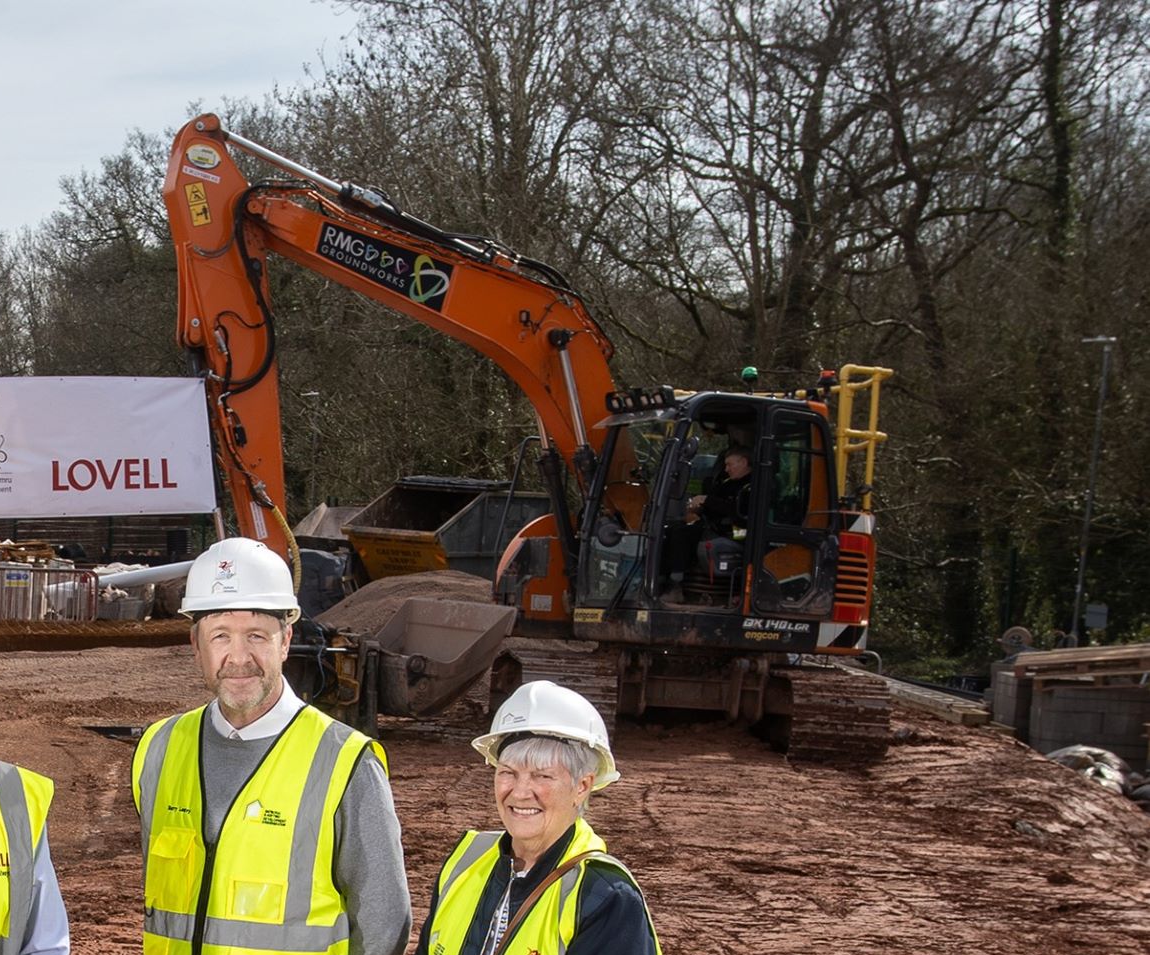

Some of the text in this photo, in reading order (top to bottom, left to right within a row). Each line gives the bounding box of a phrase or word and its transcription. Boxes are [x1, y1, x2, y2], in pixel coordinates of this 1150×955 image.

[323, 226, 365, 257] RMG
[321, 245, 405, 288] GROUNDWORKS
[52, 458, 178, 491] LOVELL
[744, 631, 780, 641] engcon
